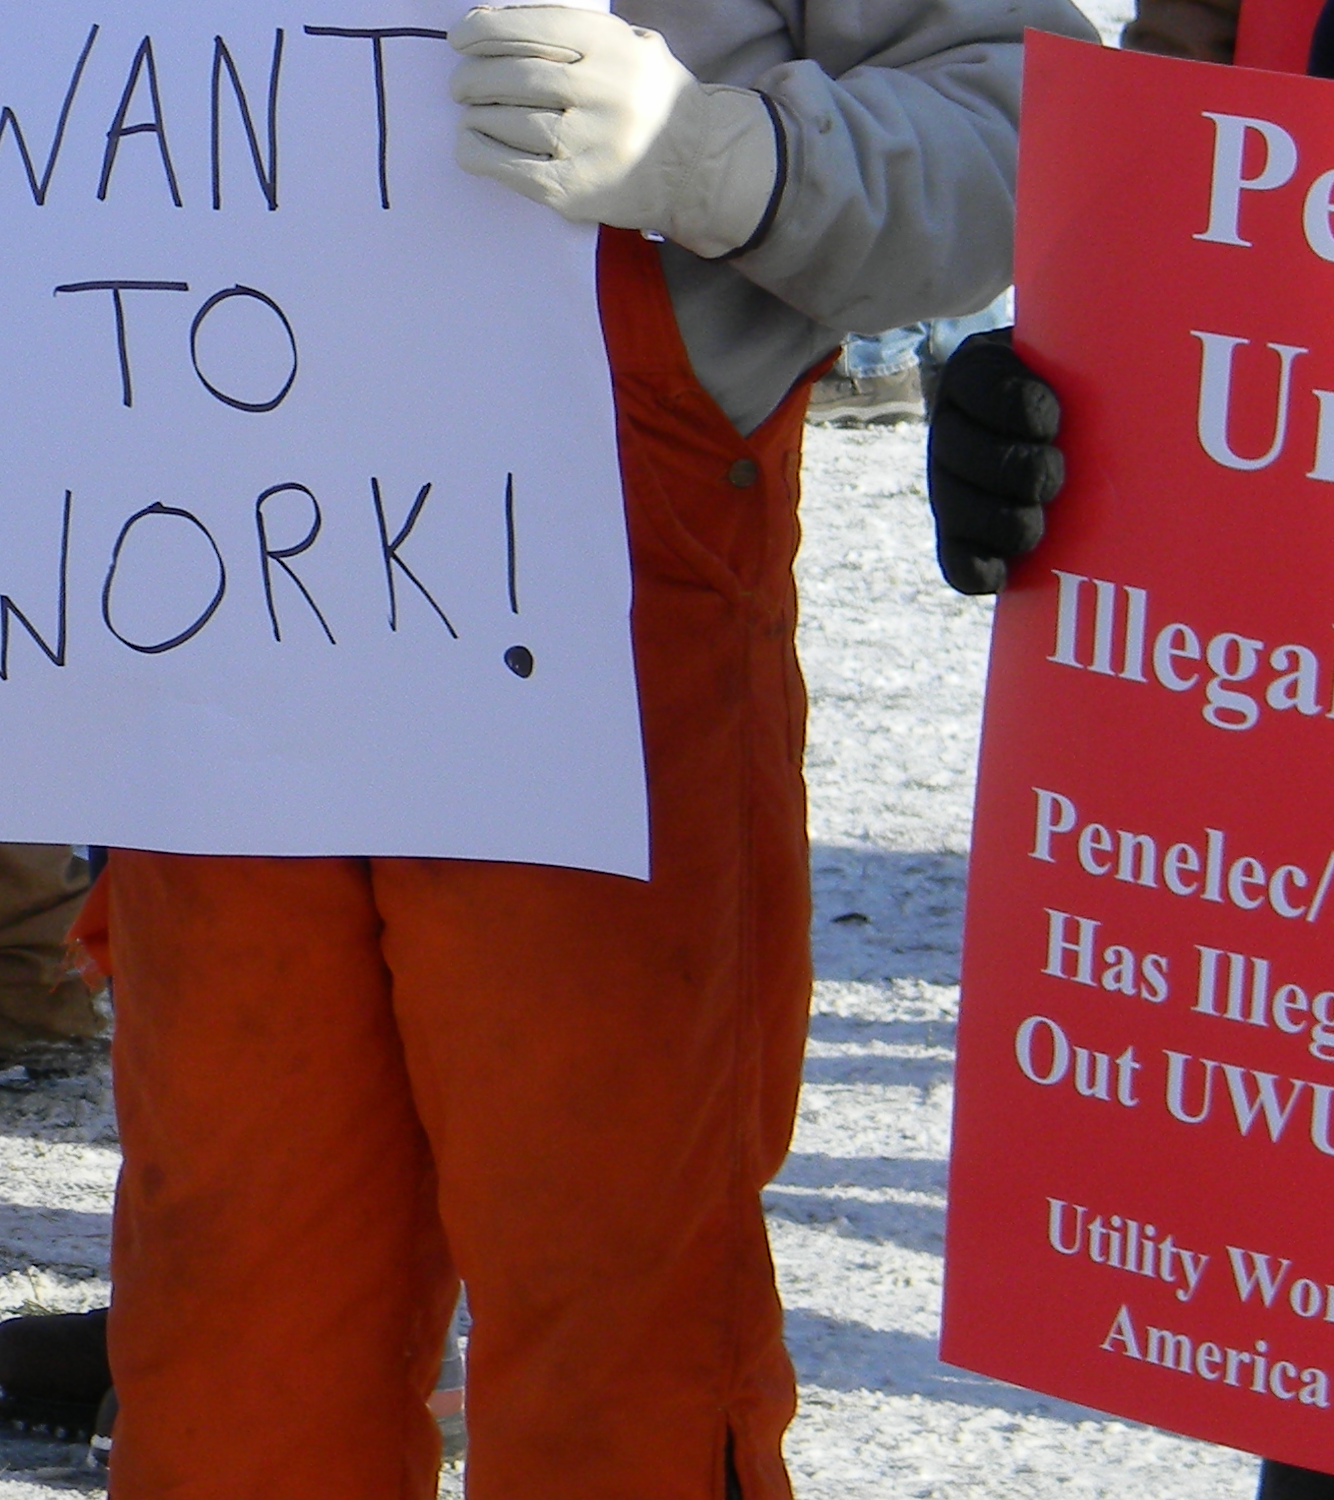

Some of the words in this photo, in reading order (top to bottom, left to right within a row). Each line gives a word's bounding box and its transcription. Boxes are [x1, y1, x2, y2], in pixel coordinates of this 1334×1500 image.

[53, 281, 299, 413] TO
[1041, 907, 1168, 1005] Has
[1014, 1014, 1143, 1107] Out
[1045, 1197, 1212, 1303] Utility
[1100, 1304, 1330, 1409] America
